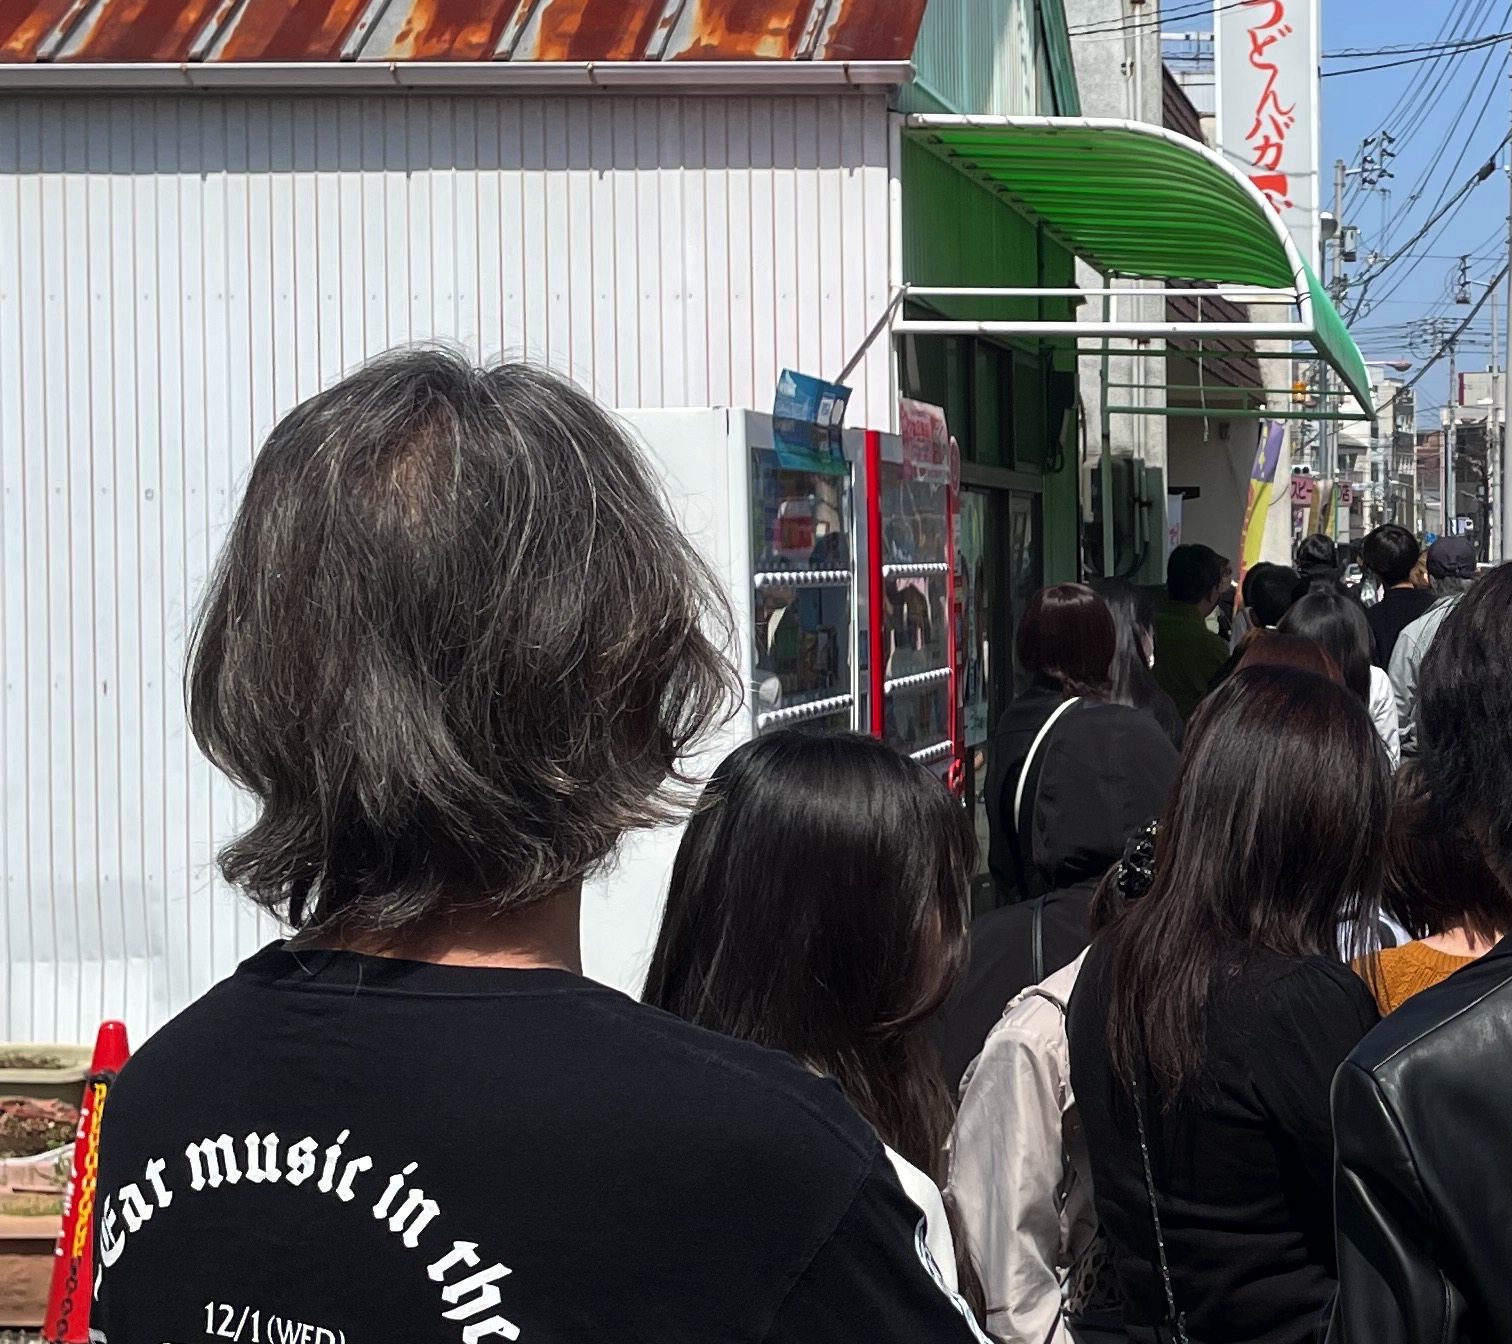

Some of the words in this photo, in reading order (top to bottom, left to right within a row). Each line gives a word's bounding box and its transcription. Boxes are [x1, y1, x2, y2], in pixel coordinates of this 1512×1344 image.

[185, 1129, 373, 1202] music
[372, 1161, 441, 1248] in
[205, 1301, 260, 1344] 12/1
